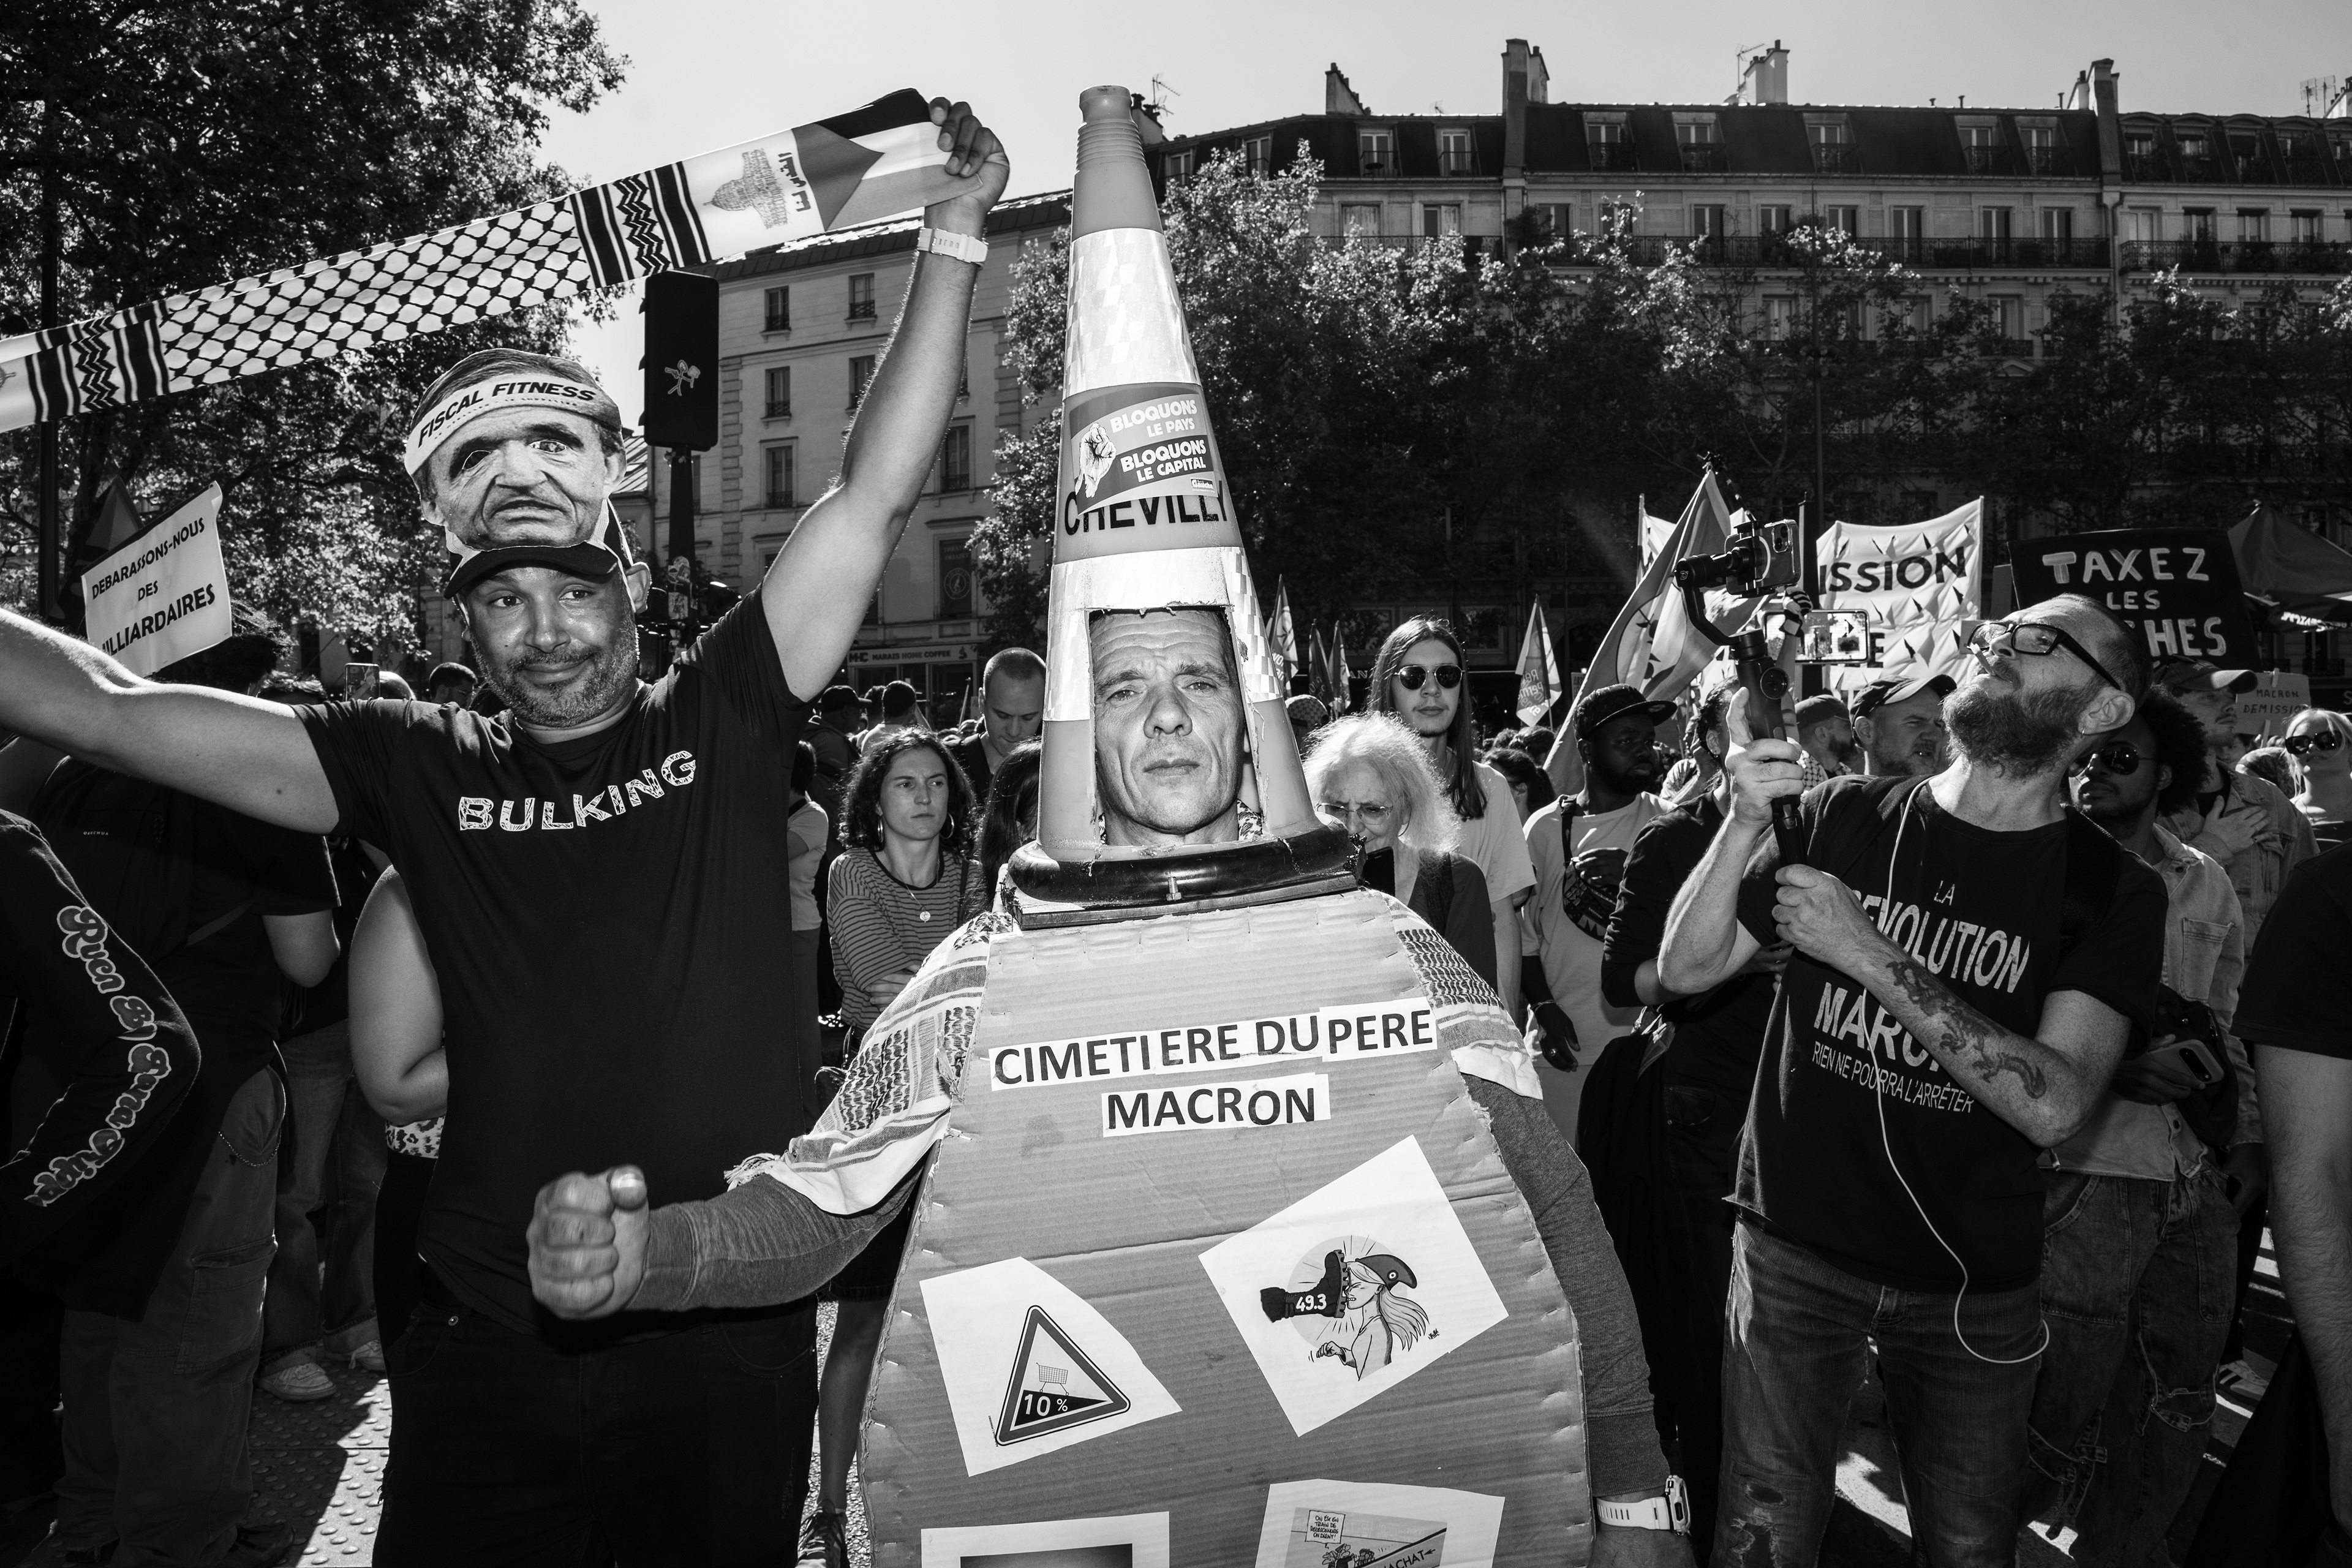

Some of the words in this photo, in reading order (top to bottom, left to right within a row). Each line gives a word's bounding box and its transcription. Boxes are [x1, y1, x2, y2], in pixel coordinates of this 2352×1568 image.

[418, 391, 483, 448] FISCAL
[491, 382, 597, 402] FITNESS
[1110, 399, 1197, 434] BLOQUONS
[1146, 423, 1164, 438] LE
[1166, 418, 1196, 434] PAYS
[1120, 439, 1207, 473] BLOQUONS
[1136, 467, 1155, 483] LE
[1156, 456, 1206, 476] CAPITAL
[91, 516, 205, 600] DEBARASSONS-NOUS
[2042, 547, 2209, 584] TAXEZ
[137, 580, 159, 601] DES
[2106, 590, 2160, 610] LES
[924, 649, 951, 658] COFFEE
[2256, 688, 2299, 699] MACRON
[459, 750, 696, 831] BULKING
[1934, 880, 1955, 906] LA
[994, 1023, 1240, 1085] CIMETIERE
[1255, 1015, 1319, 1056] DU
[1329, 1009, 1433, 1054] PERE
[1812, 1041, 1836, 1071] RIEN
[1834, 1052, 1852, 1079] NE
[1851, 1059, 1904, 1099] POURRA
[1904, 1078, 1974, 1114] L'ARRÊTER
[1108, 1087, 1314, 1130] MACRON
[1295, 1294, 1327, 1312] 49.3
[1024, 1394, 1050, 1417] 10
[1057, 1398, 1068, 1412] %
